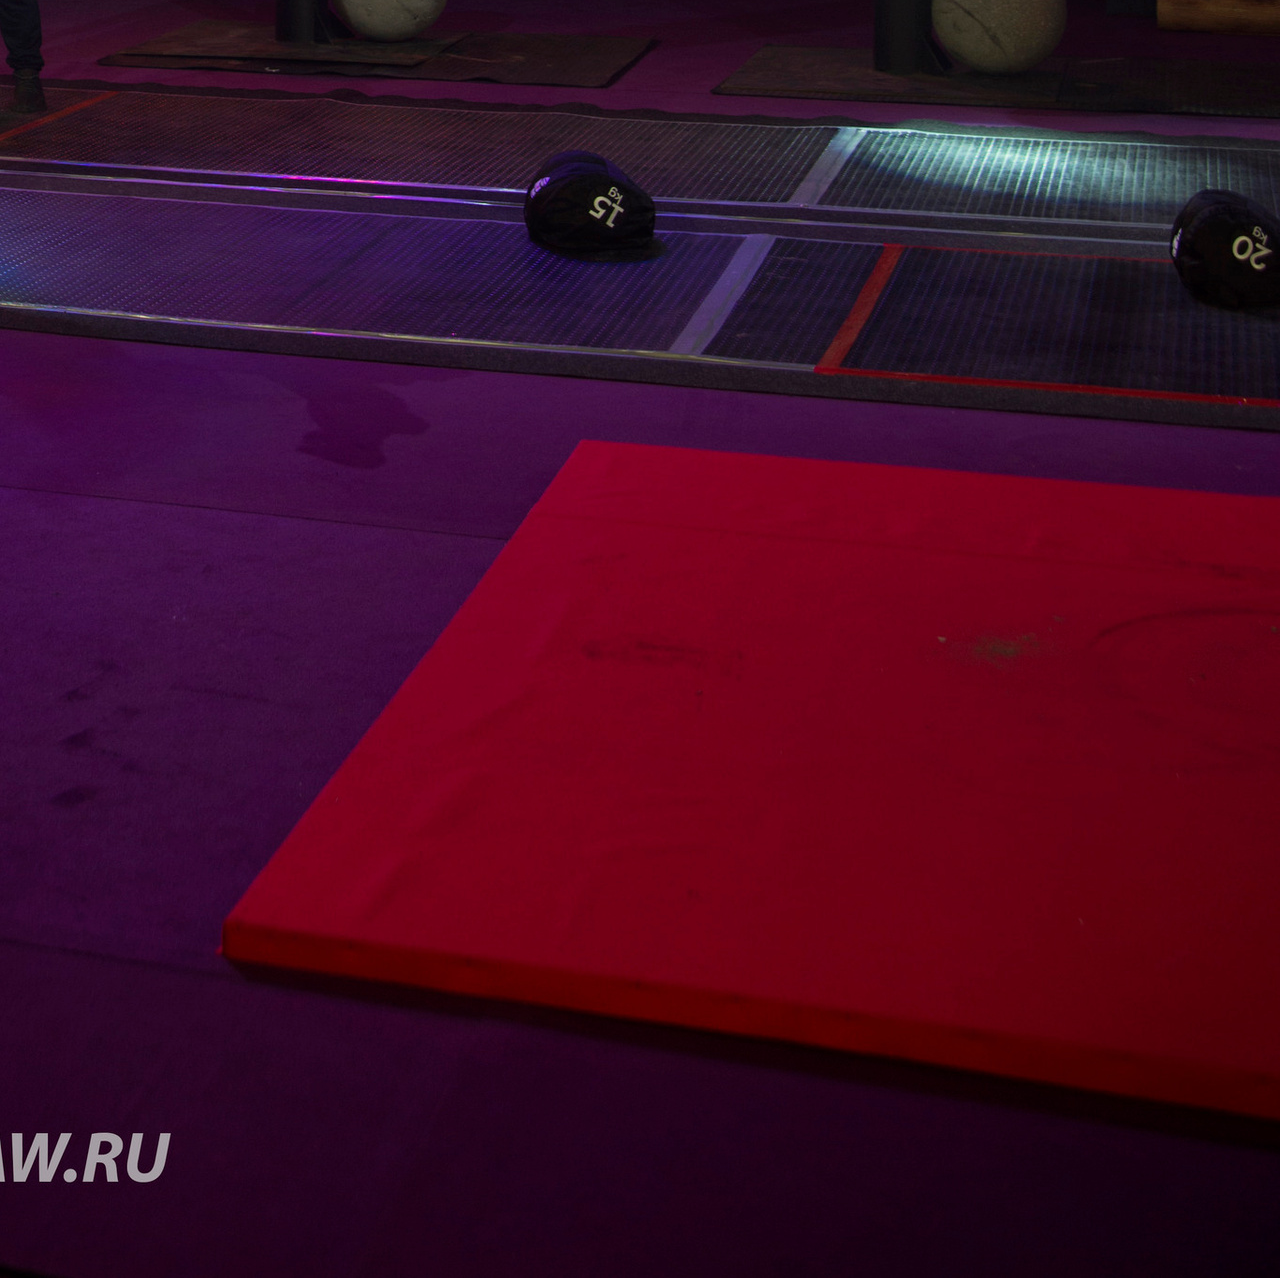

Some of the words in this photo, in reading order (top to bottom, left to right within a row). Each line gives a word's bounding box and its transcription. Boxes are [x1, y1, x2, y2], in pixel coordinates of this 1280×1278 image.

[608, 186, 624, 205] kg
[588, 195, 625, 228] 15
[1252, 225, 1268, 245] kg
[1232, 235, 1273, 271] 20
